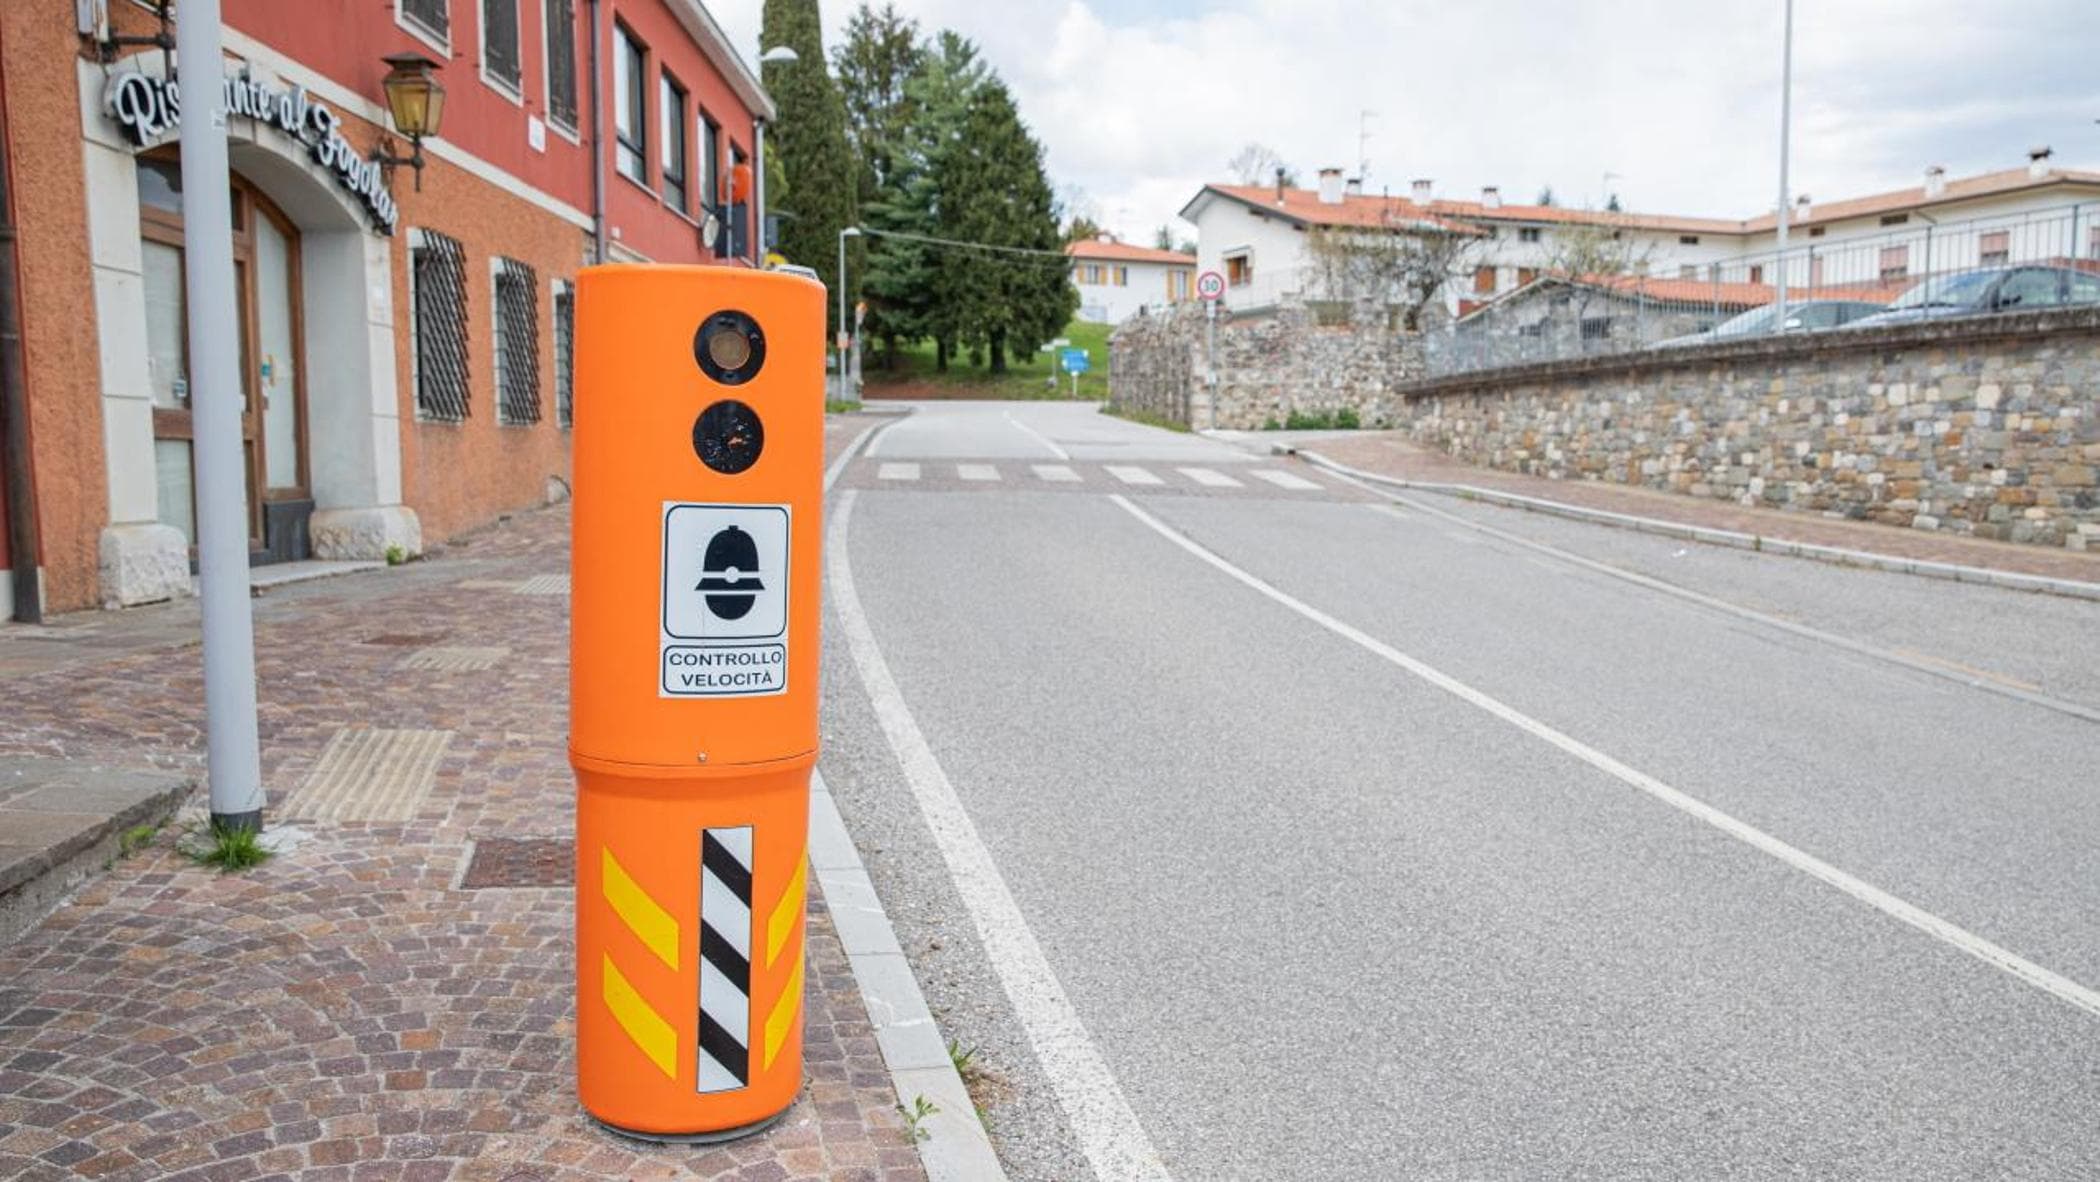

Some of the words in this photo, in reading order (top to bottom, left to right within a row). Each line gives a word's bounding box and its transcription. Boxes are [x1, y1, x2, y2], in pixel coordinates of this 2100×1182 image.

[115, 72, 272, 146] Risante
[280, 87, 308, 139] al
[669, 651, 783, 666] CONTROLLO
[681, 671, 773, 687] VELOCITÀ
